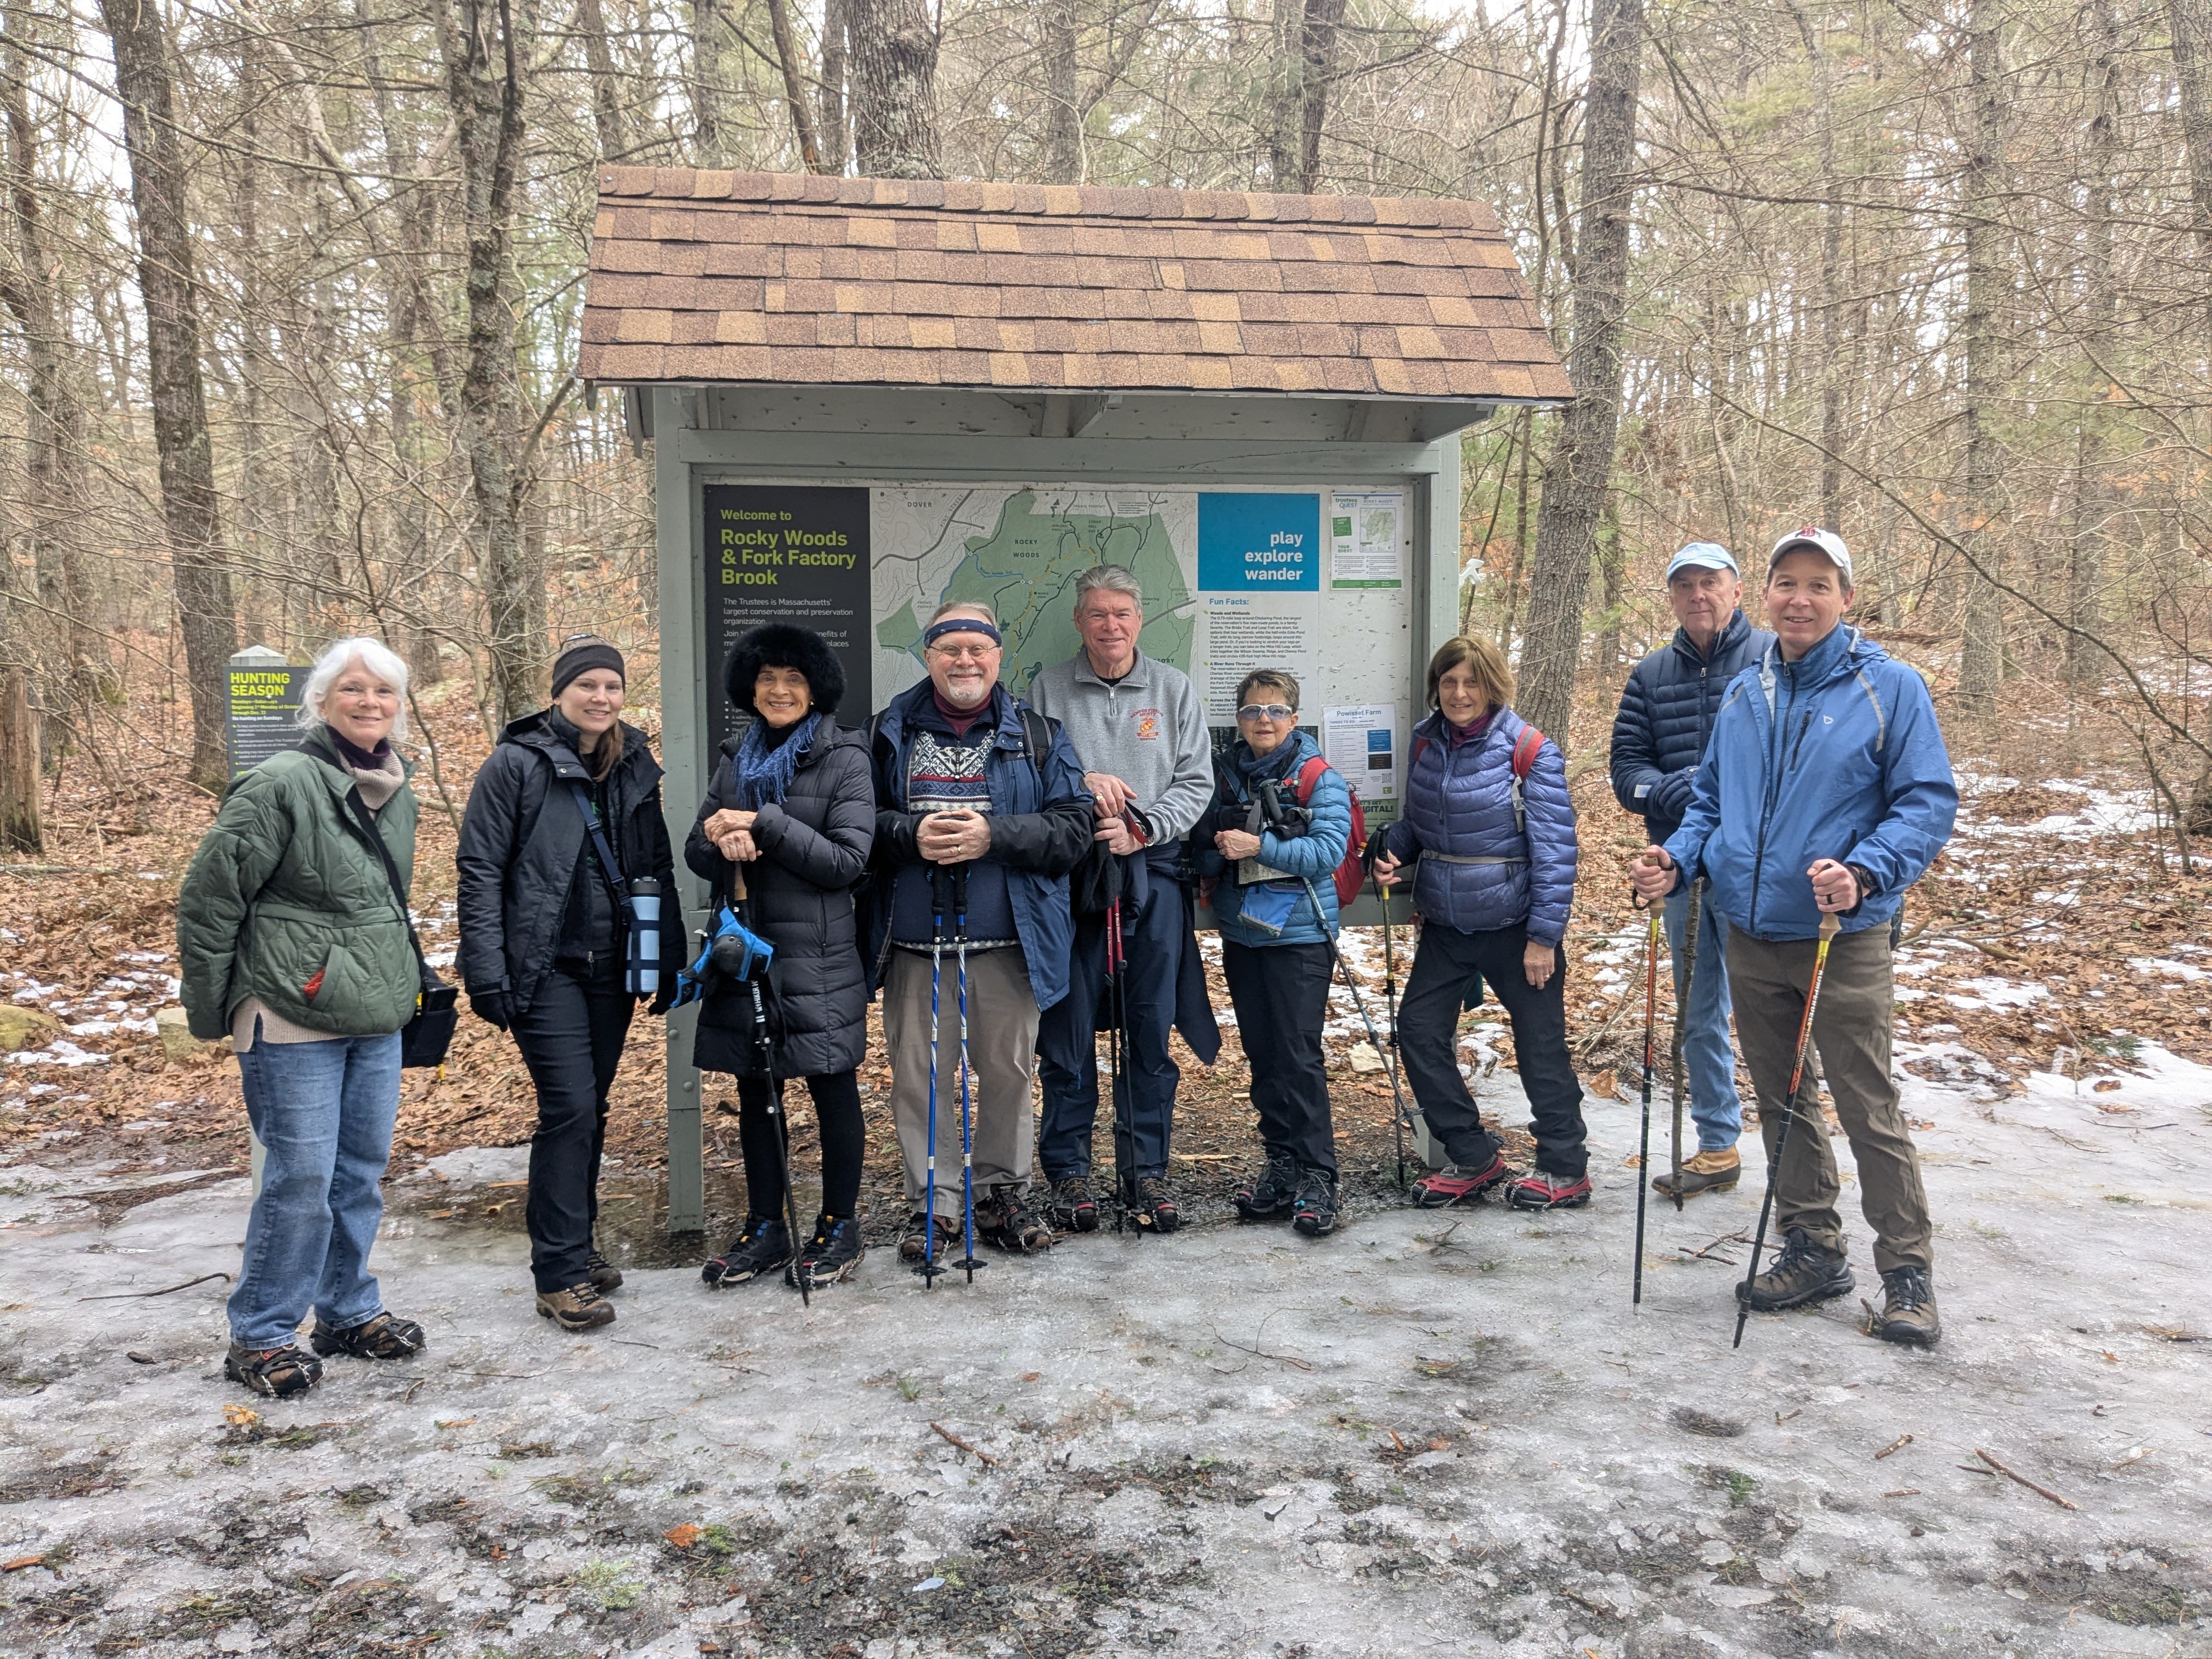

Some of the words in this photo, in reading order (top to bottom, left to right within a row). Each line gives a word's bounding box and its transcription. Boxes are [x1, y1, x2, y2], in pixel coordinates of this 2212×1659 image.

[720, 509, 777, 521] Welcome
[780, 511, 792, 521] to
[721, 529, 779, 549] Rocky
[784, 530, 848, 546] Woods
[1270, 531, 1303, 547] play
[721, 549, 737, 565] &
[742, 549, 783, 565] Fork
[788, 550, 856, 569] Factory
[1245, 549, 1303, 565] explore
[722, 569, 778, 585] Brook
[1245, 567, 1303, 580] wander
[724, 608, 748, 616] largest
[230, 673, 290, 684] HUNTING
[231, 685, 285, 696] SEASON
